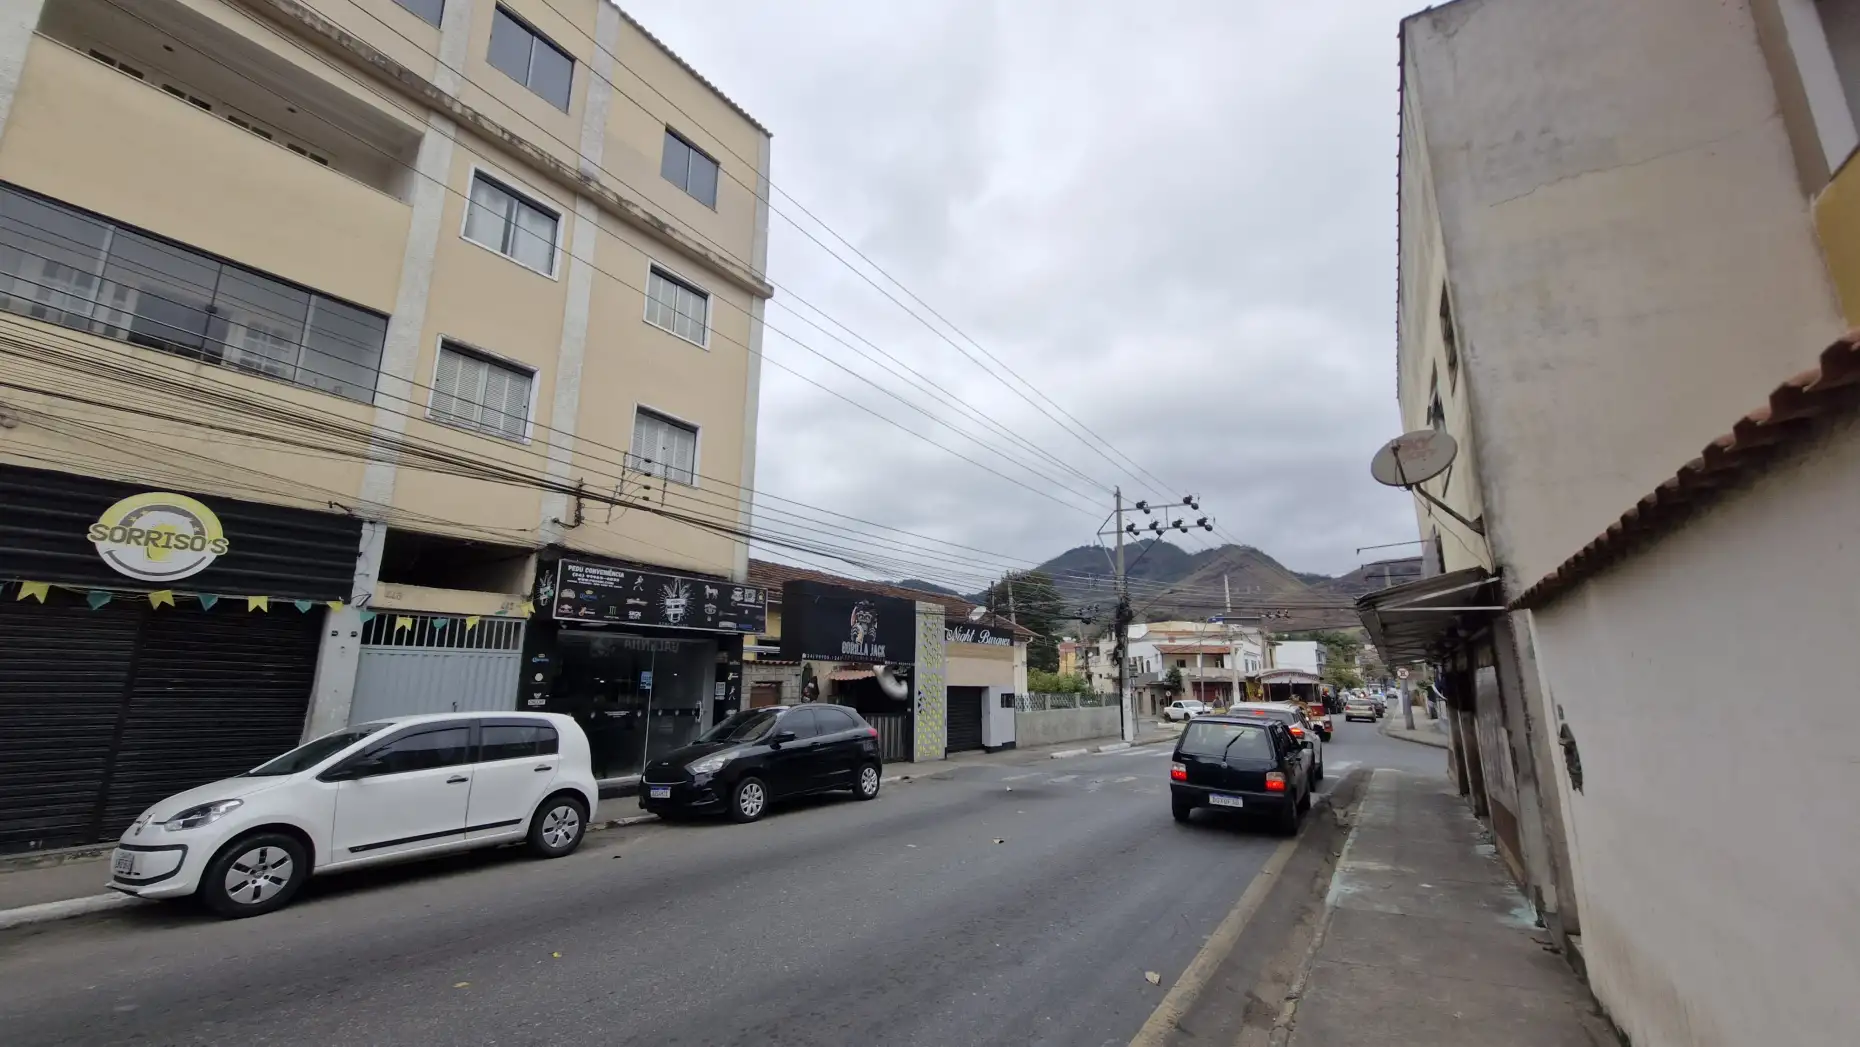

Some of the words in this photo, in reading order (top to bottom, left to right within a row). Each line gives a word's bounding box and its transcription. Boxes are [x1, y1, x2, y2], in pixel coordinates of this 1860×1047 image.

[89, 523, 228, 554] SORRISO'S
[568, 565, 584, 573] PEDU
[842, 641, 868, 656] GORILLA
[870, 644, 886, 657] JACK
